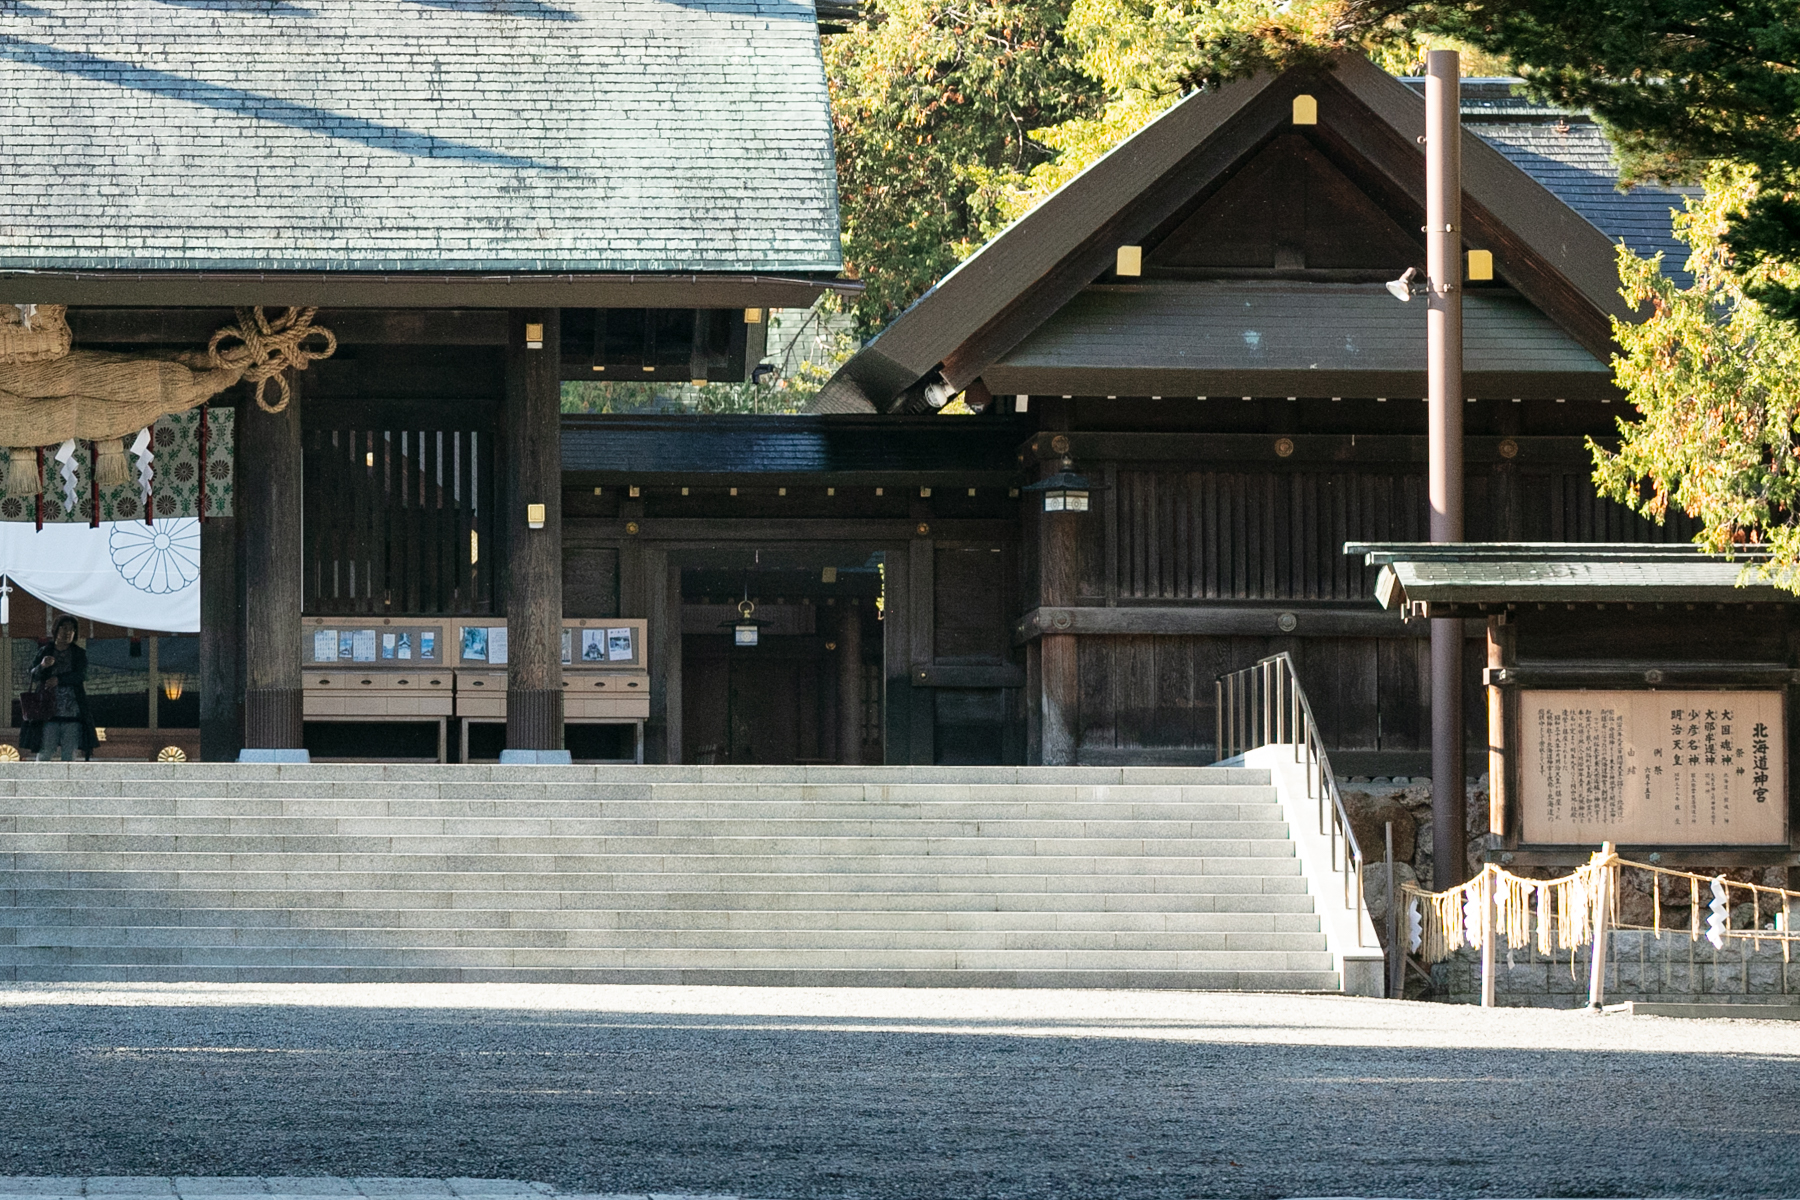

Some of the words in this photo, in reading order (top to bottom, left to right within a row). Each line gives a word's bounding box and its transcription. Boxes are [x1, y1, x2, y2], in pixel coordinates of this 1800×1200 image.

[1627, 748, 1637, 776] 由緒
[1654, 748, 1663, 776] 例祭
[1670, 709, 1683, 767] 明治天皇
[1687, 709, 1700, 767] 少彦名神
[1752, 722, 1770, 803] 北海道神宮
